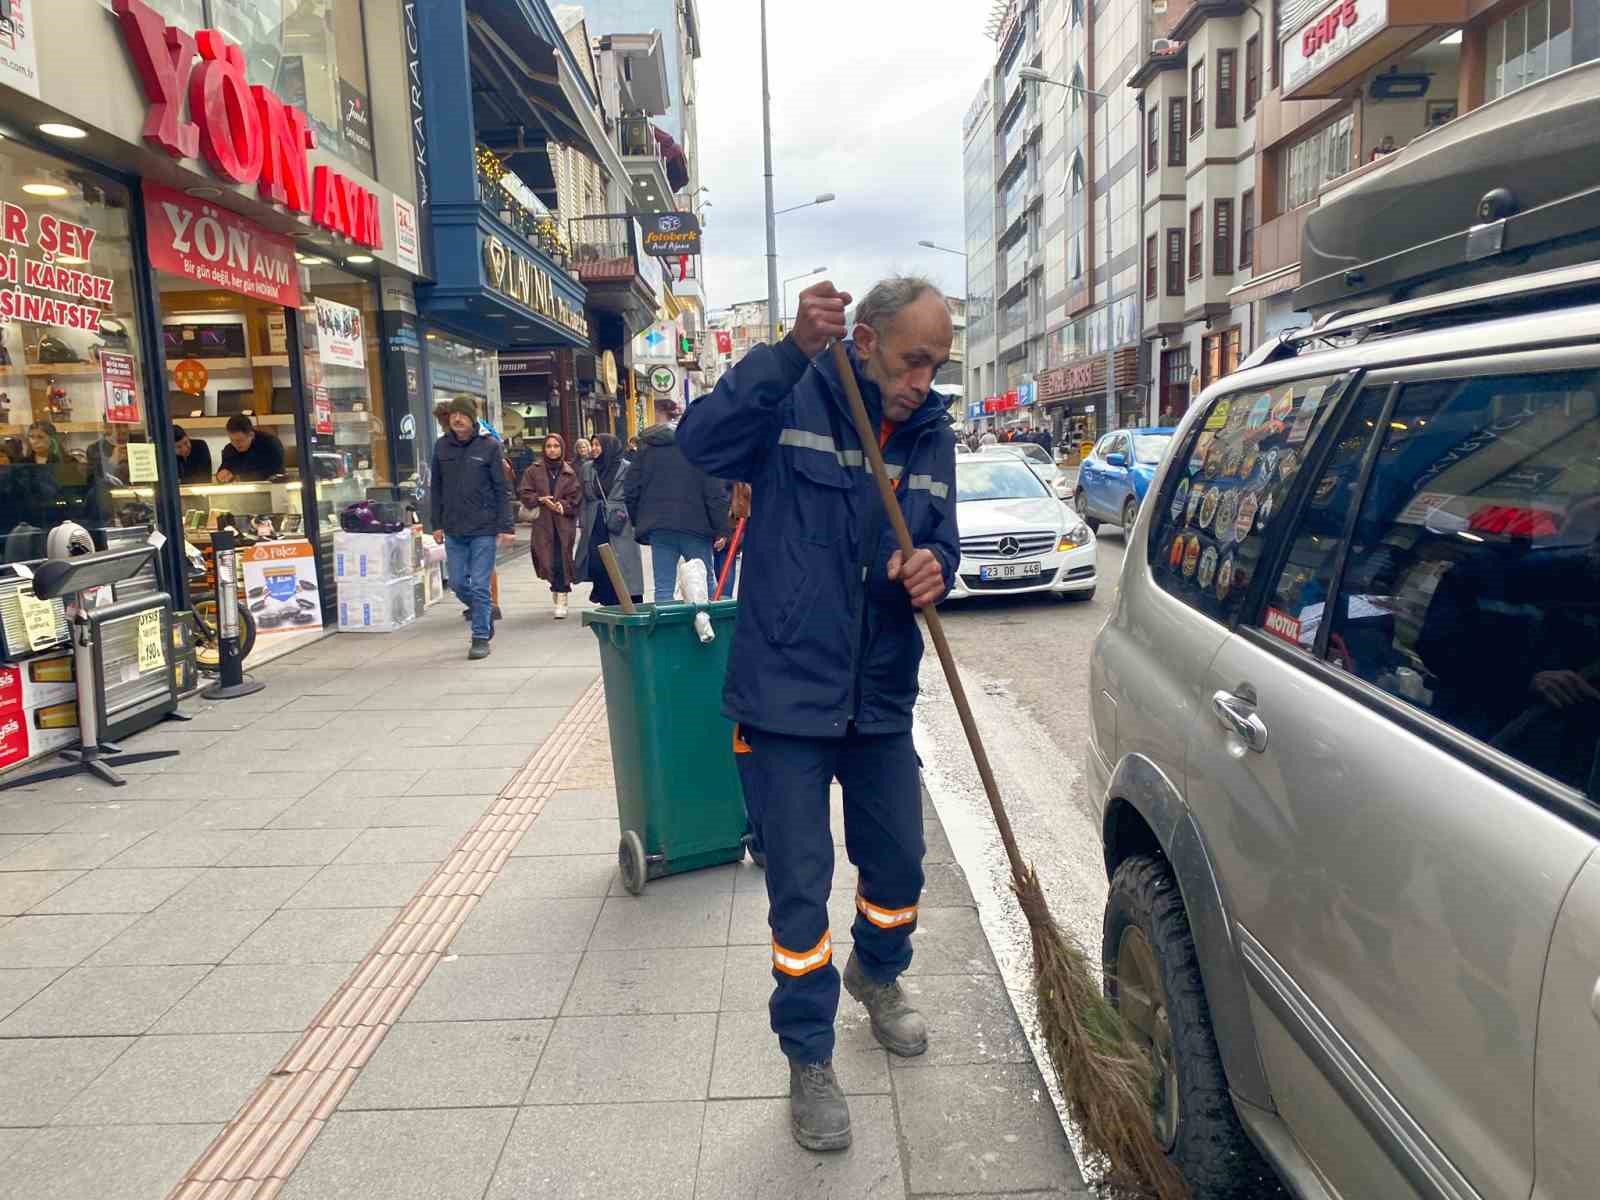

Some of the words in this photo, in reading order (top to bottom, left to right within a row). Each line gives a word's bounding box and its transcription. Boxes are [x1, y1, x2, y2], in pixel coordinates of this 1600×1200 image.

[1301, 0, 1358, 57] CAFE
[405, 3, 427, 167] KARACA
[112, 0, 318, 213] YÖN
[311, 165, 383, 250] AVM
[37, 214, 97, 264] ŞEY
[161, 202, 250, 272] YÖN
[253, 252, 289, 286] AVM
[24, 258, 114, 304] KARTSIZ
[0, 285, 102, 334] ŞİNATSIZ
[1266, 610, 1299, 640] MOTUL
[0, 671, 15, 687] sis
